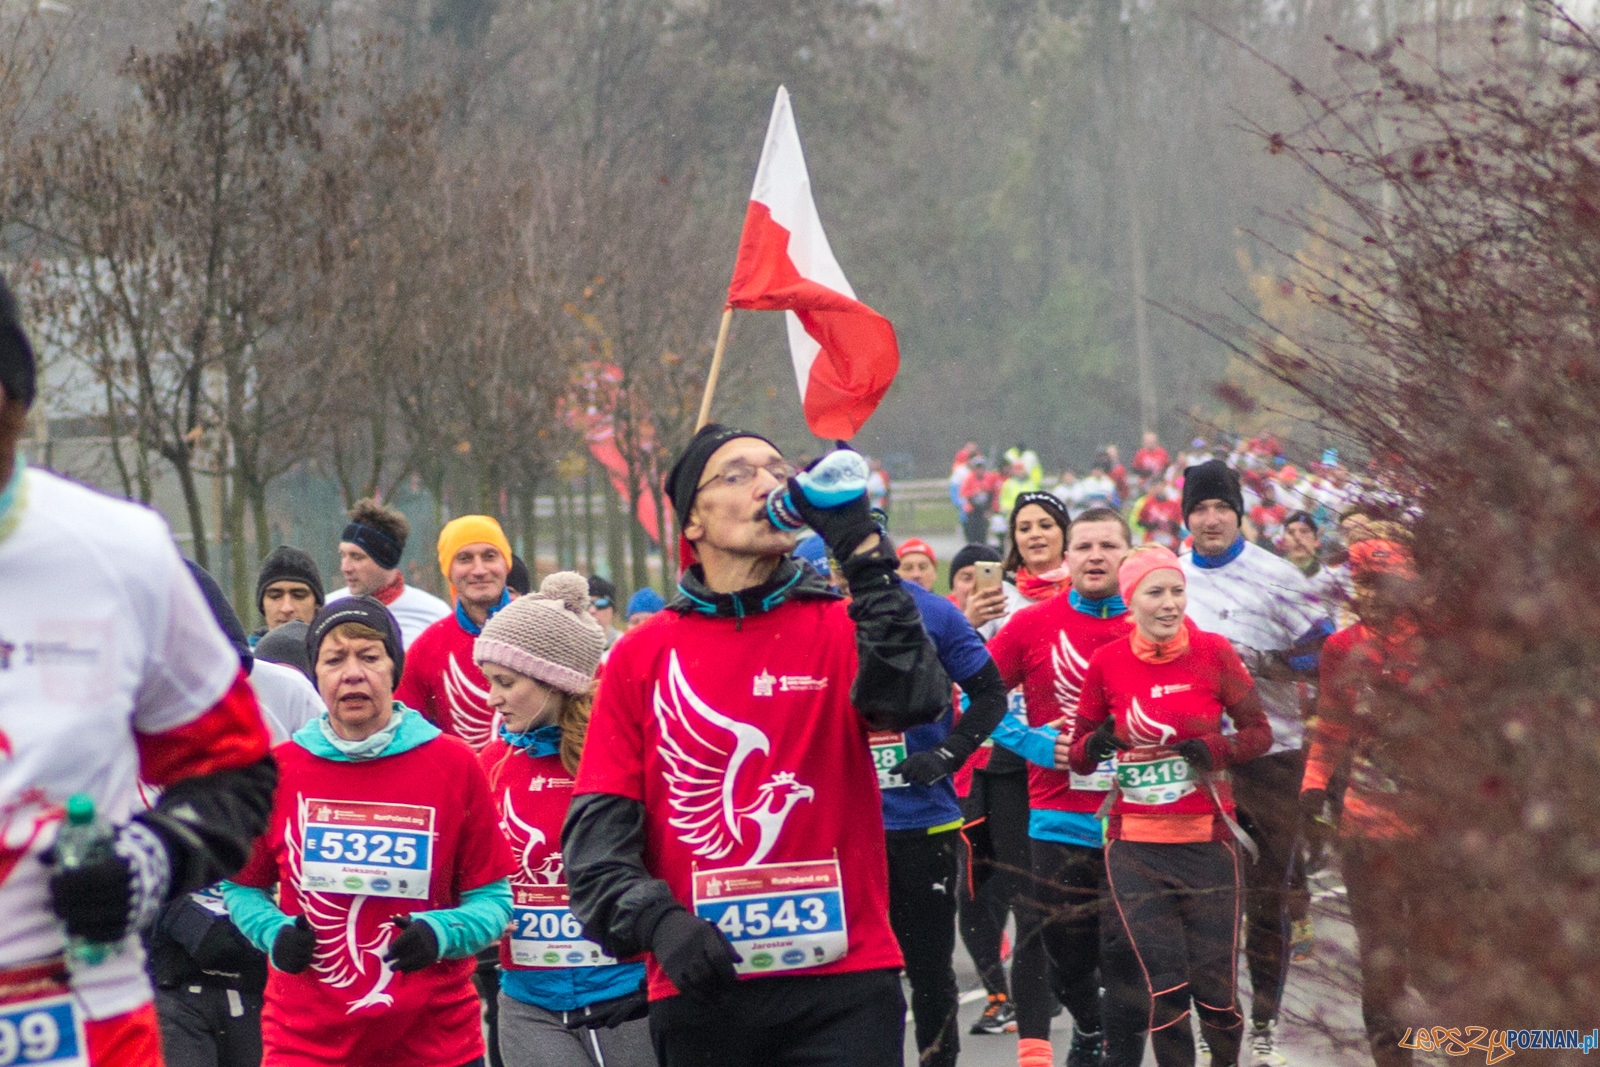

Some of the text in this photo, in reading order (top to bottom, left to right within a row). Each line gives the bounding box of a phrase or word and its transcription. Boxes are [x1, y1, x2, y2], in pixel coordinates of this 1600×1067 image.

[1126, 760, 1188, 786] 3419
[307, 832, 417, 866] E 5325
[521, 912, 582, 938] 206
[717, 897, 828, 937] 4543
